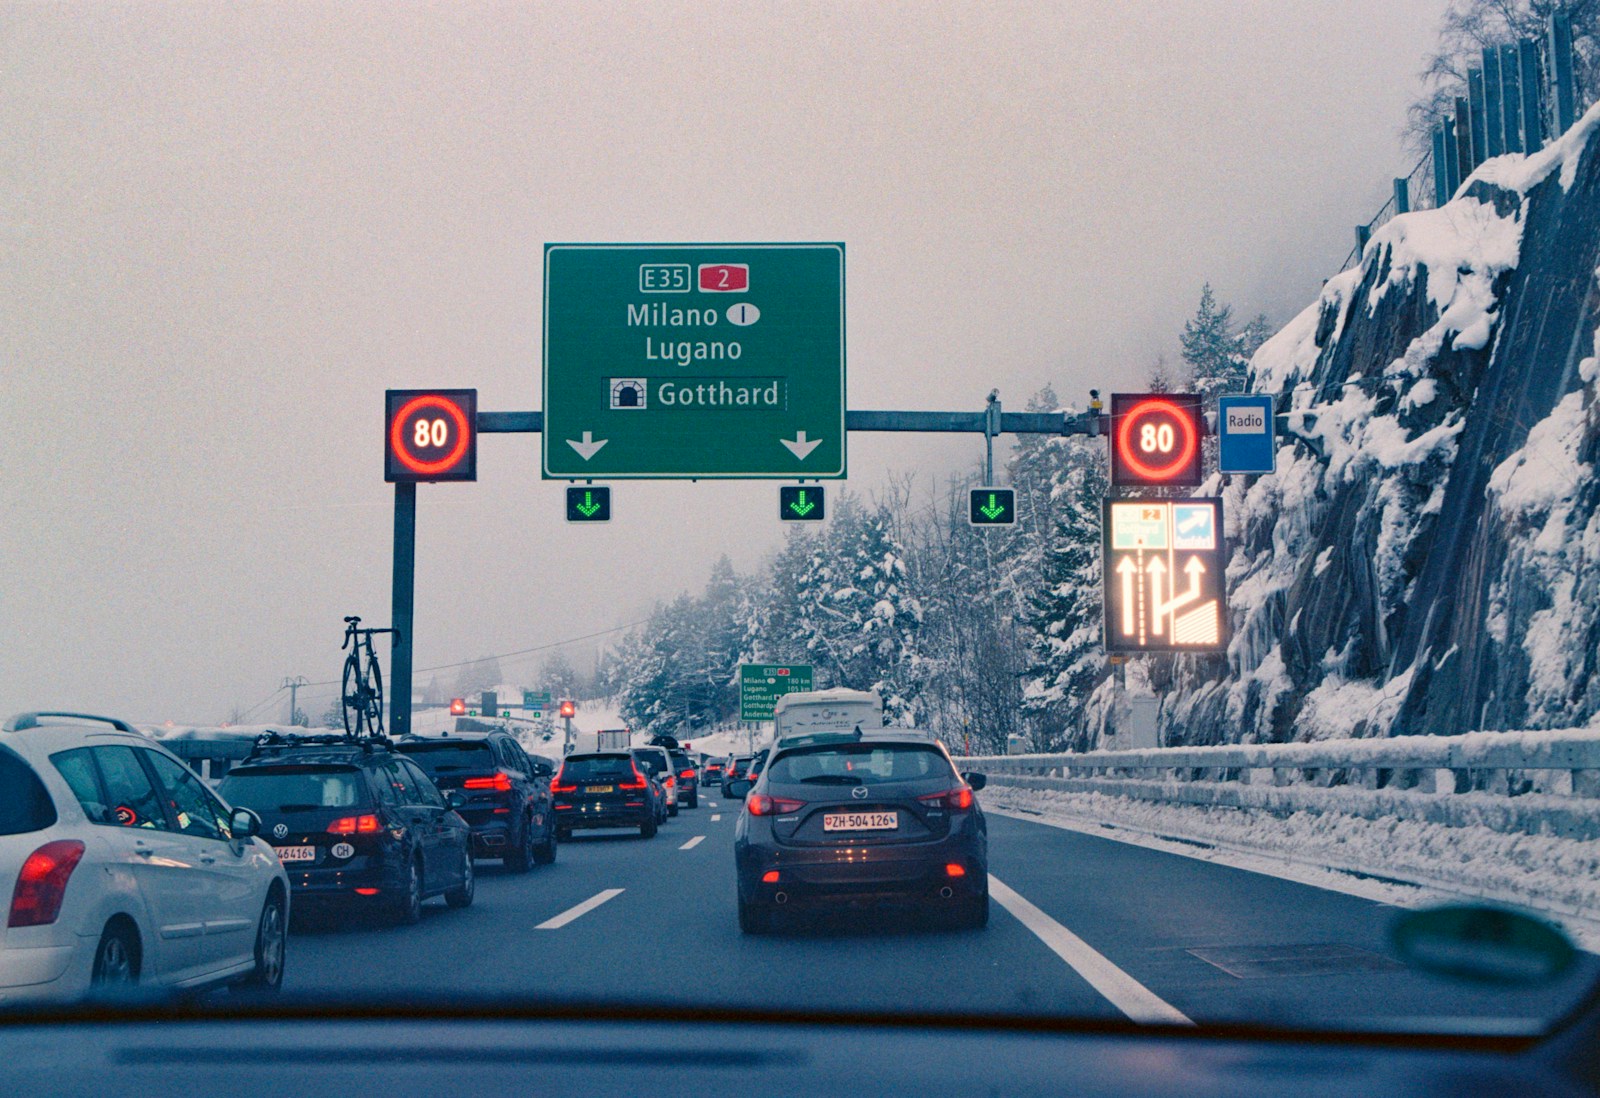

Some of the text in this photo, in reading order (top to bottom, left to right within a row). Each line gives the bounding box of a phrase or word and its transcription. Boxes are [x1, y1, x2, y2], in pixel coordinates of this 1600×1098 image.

[644, 269, 684, 288] E35
[718, 269, 730, 288] 2
[627, 303, 718, 327] Milano
[646, 337, 742, 366] Lugano
[658, 381, 778, 406] Gotthard
[1229, 414, 1263, 428] Radio
[414, 418, 448, 447] 80
[1140, 423, 1174, 453] 80
[1147, 509, 1155, 520] 2
[743, 685, 767, 693] Lugano
[336, 845, 350, 857] CH
